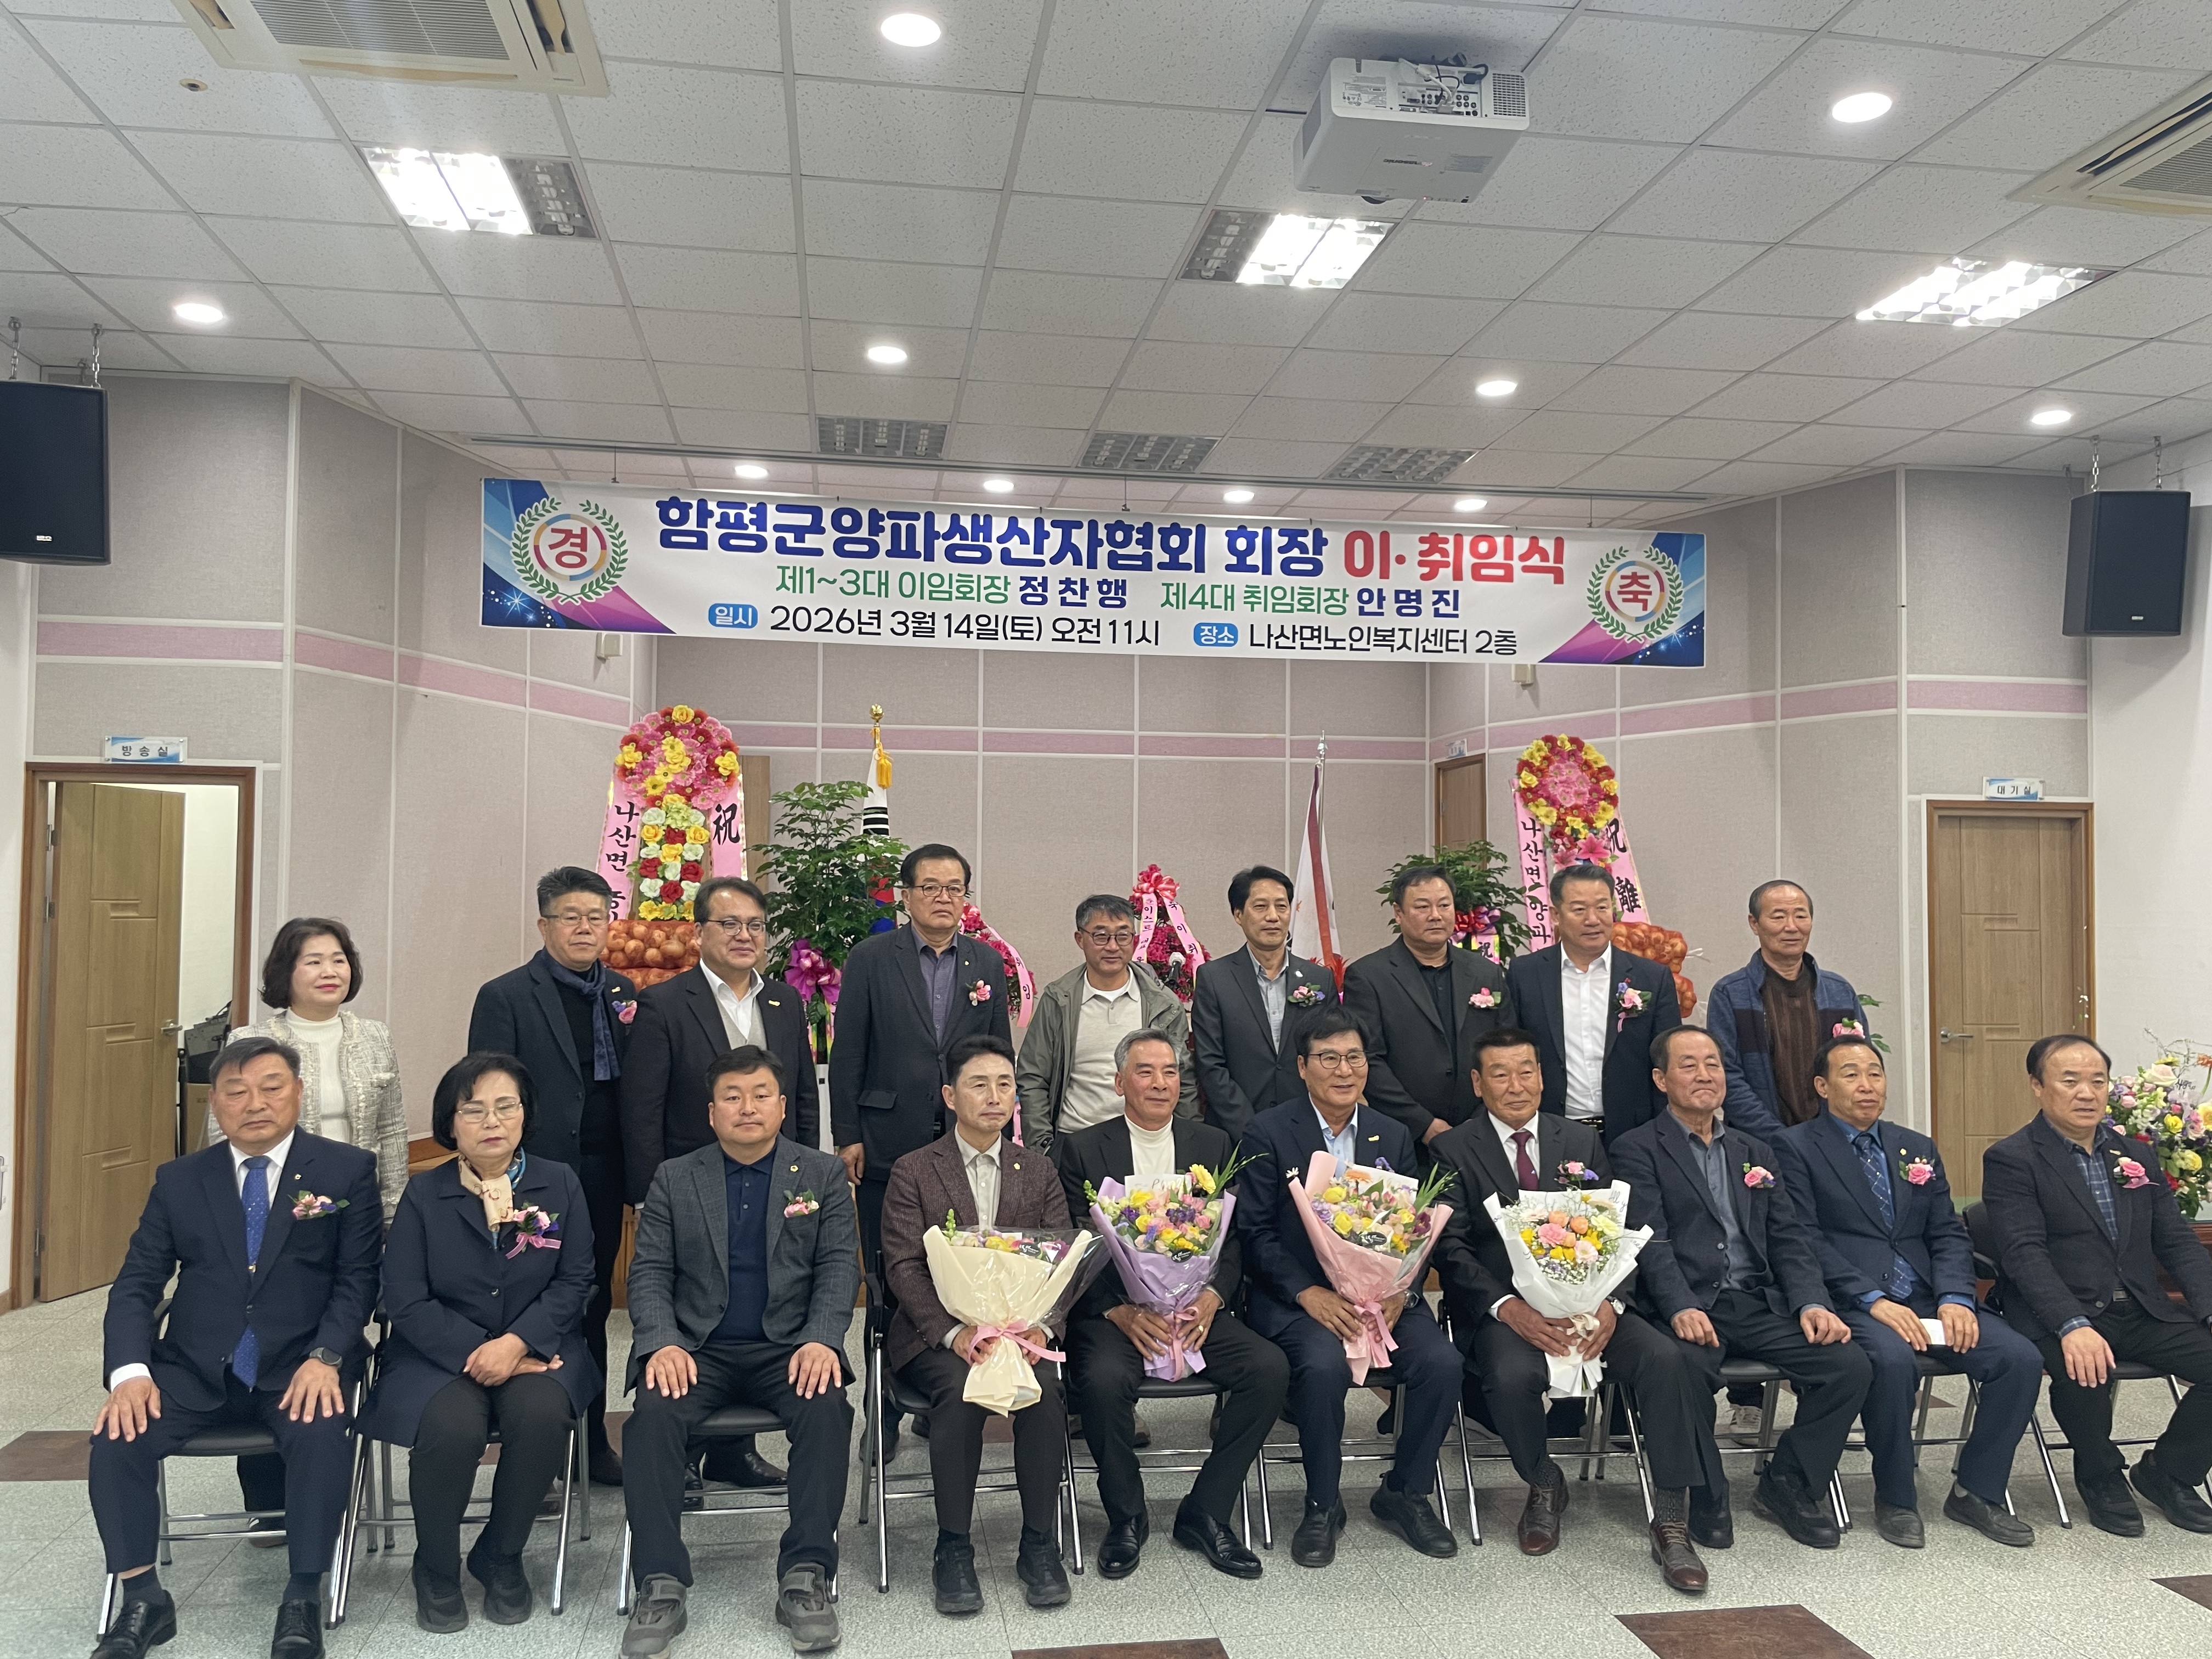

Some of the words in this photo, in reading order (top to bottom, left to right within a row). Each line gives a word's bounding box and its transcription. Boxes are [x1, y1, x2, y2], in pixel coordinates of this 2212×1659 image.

[548, 527, 588, 568] 경
[656, 496, 1206, 573] 함평군양파생산자협회
[1224, 525, 1328, 577] 회장
[776, 565, 889, 598] 제1~3대
[899, 571, 1011, 603] 이임회장
[1160, 583, 1234, 611] 제4대
[1243, 584, 1349, 616] 취임회장
[1617, 572, 1652, 612] 축
[715, 606, 752, 626] 일시
[770, 606, 881, 636] 2026년
[890, 611, 935, 639] 3월
[944, 613, 1042, 641] 14일(토)
[1052, 617, 1101, 644] 오전
[1109, 619, 1159, 646] 11시
[1200, 626, 1234, 645] 장소
[1250, 624, 1467, 654] 나산면노인복지센터
[1475, 629, 1517, 656] 2층
[606, 802, 640, 872] 나산면
[713, 803, 740, 845] 祝
[1530, 900, 1551, 944] 양파
